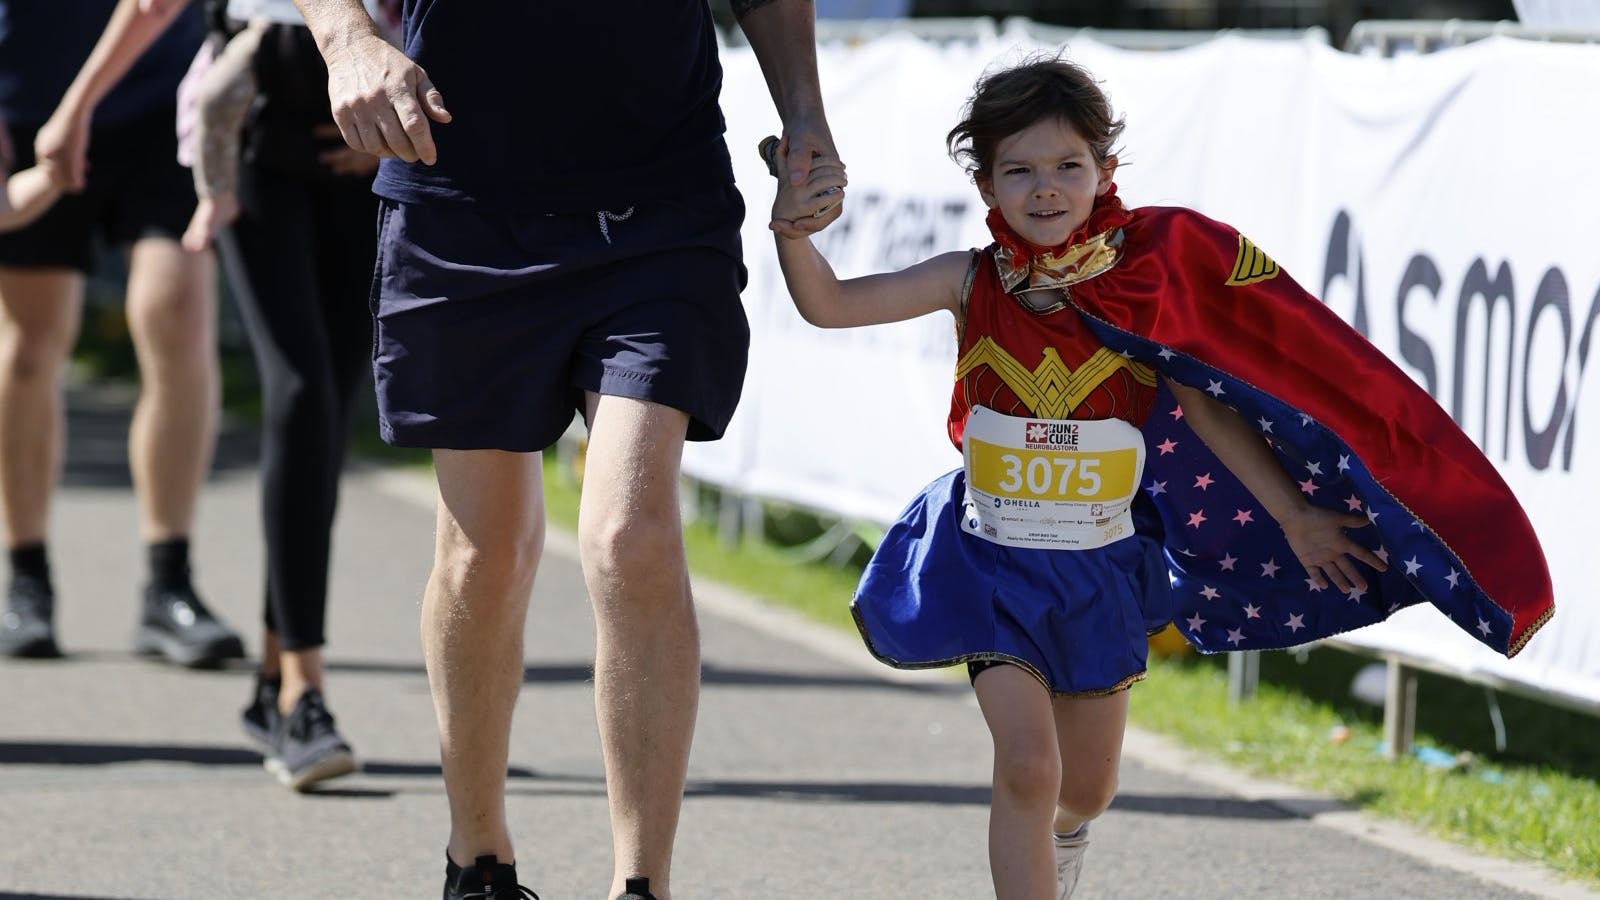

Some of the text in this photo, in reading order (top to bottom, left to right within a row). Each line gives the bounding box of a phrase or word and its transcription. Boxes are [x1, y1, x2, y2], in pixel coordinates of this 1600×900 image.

[1049, 434, 1079, 445] CURE
[1025, 444, 1079, 452] NEUROBLASTOMA
[1000, 454, 1101, 496] 3075
[1003, 499, 1041, 508] GHELLA
[1103, 524, 1124, 541] 3075
